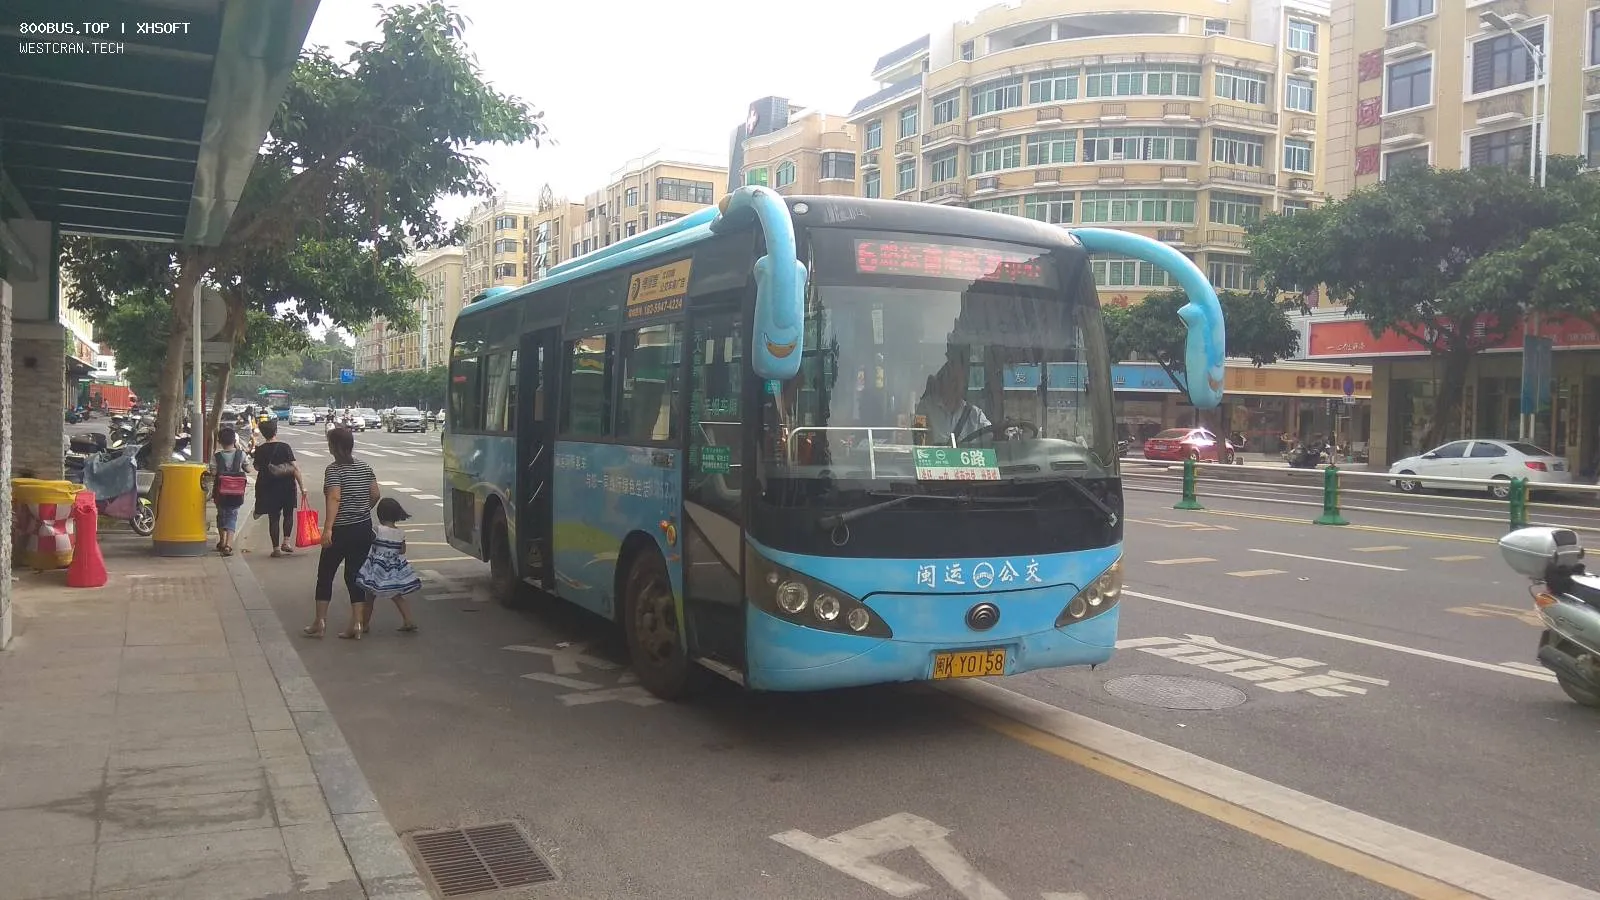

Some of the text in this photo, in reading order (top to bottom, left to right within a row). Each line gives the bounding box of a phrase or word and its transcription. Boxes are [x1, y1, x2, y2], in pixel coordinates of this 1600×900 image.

[960, 449, 986, 467] 6路
[917, 558, 1043, 588] 闽运 公交
